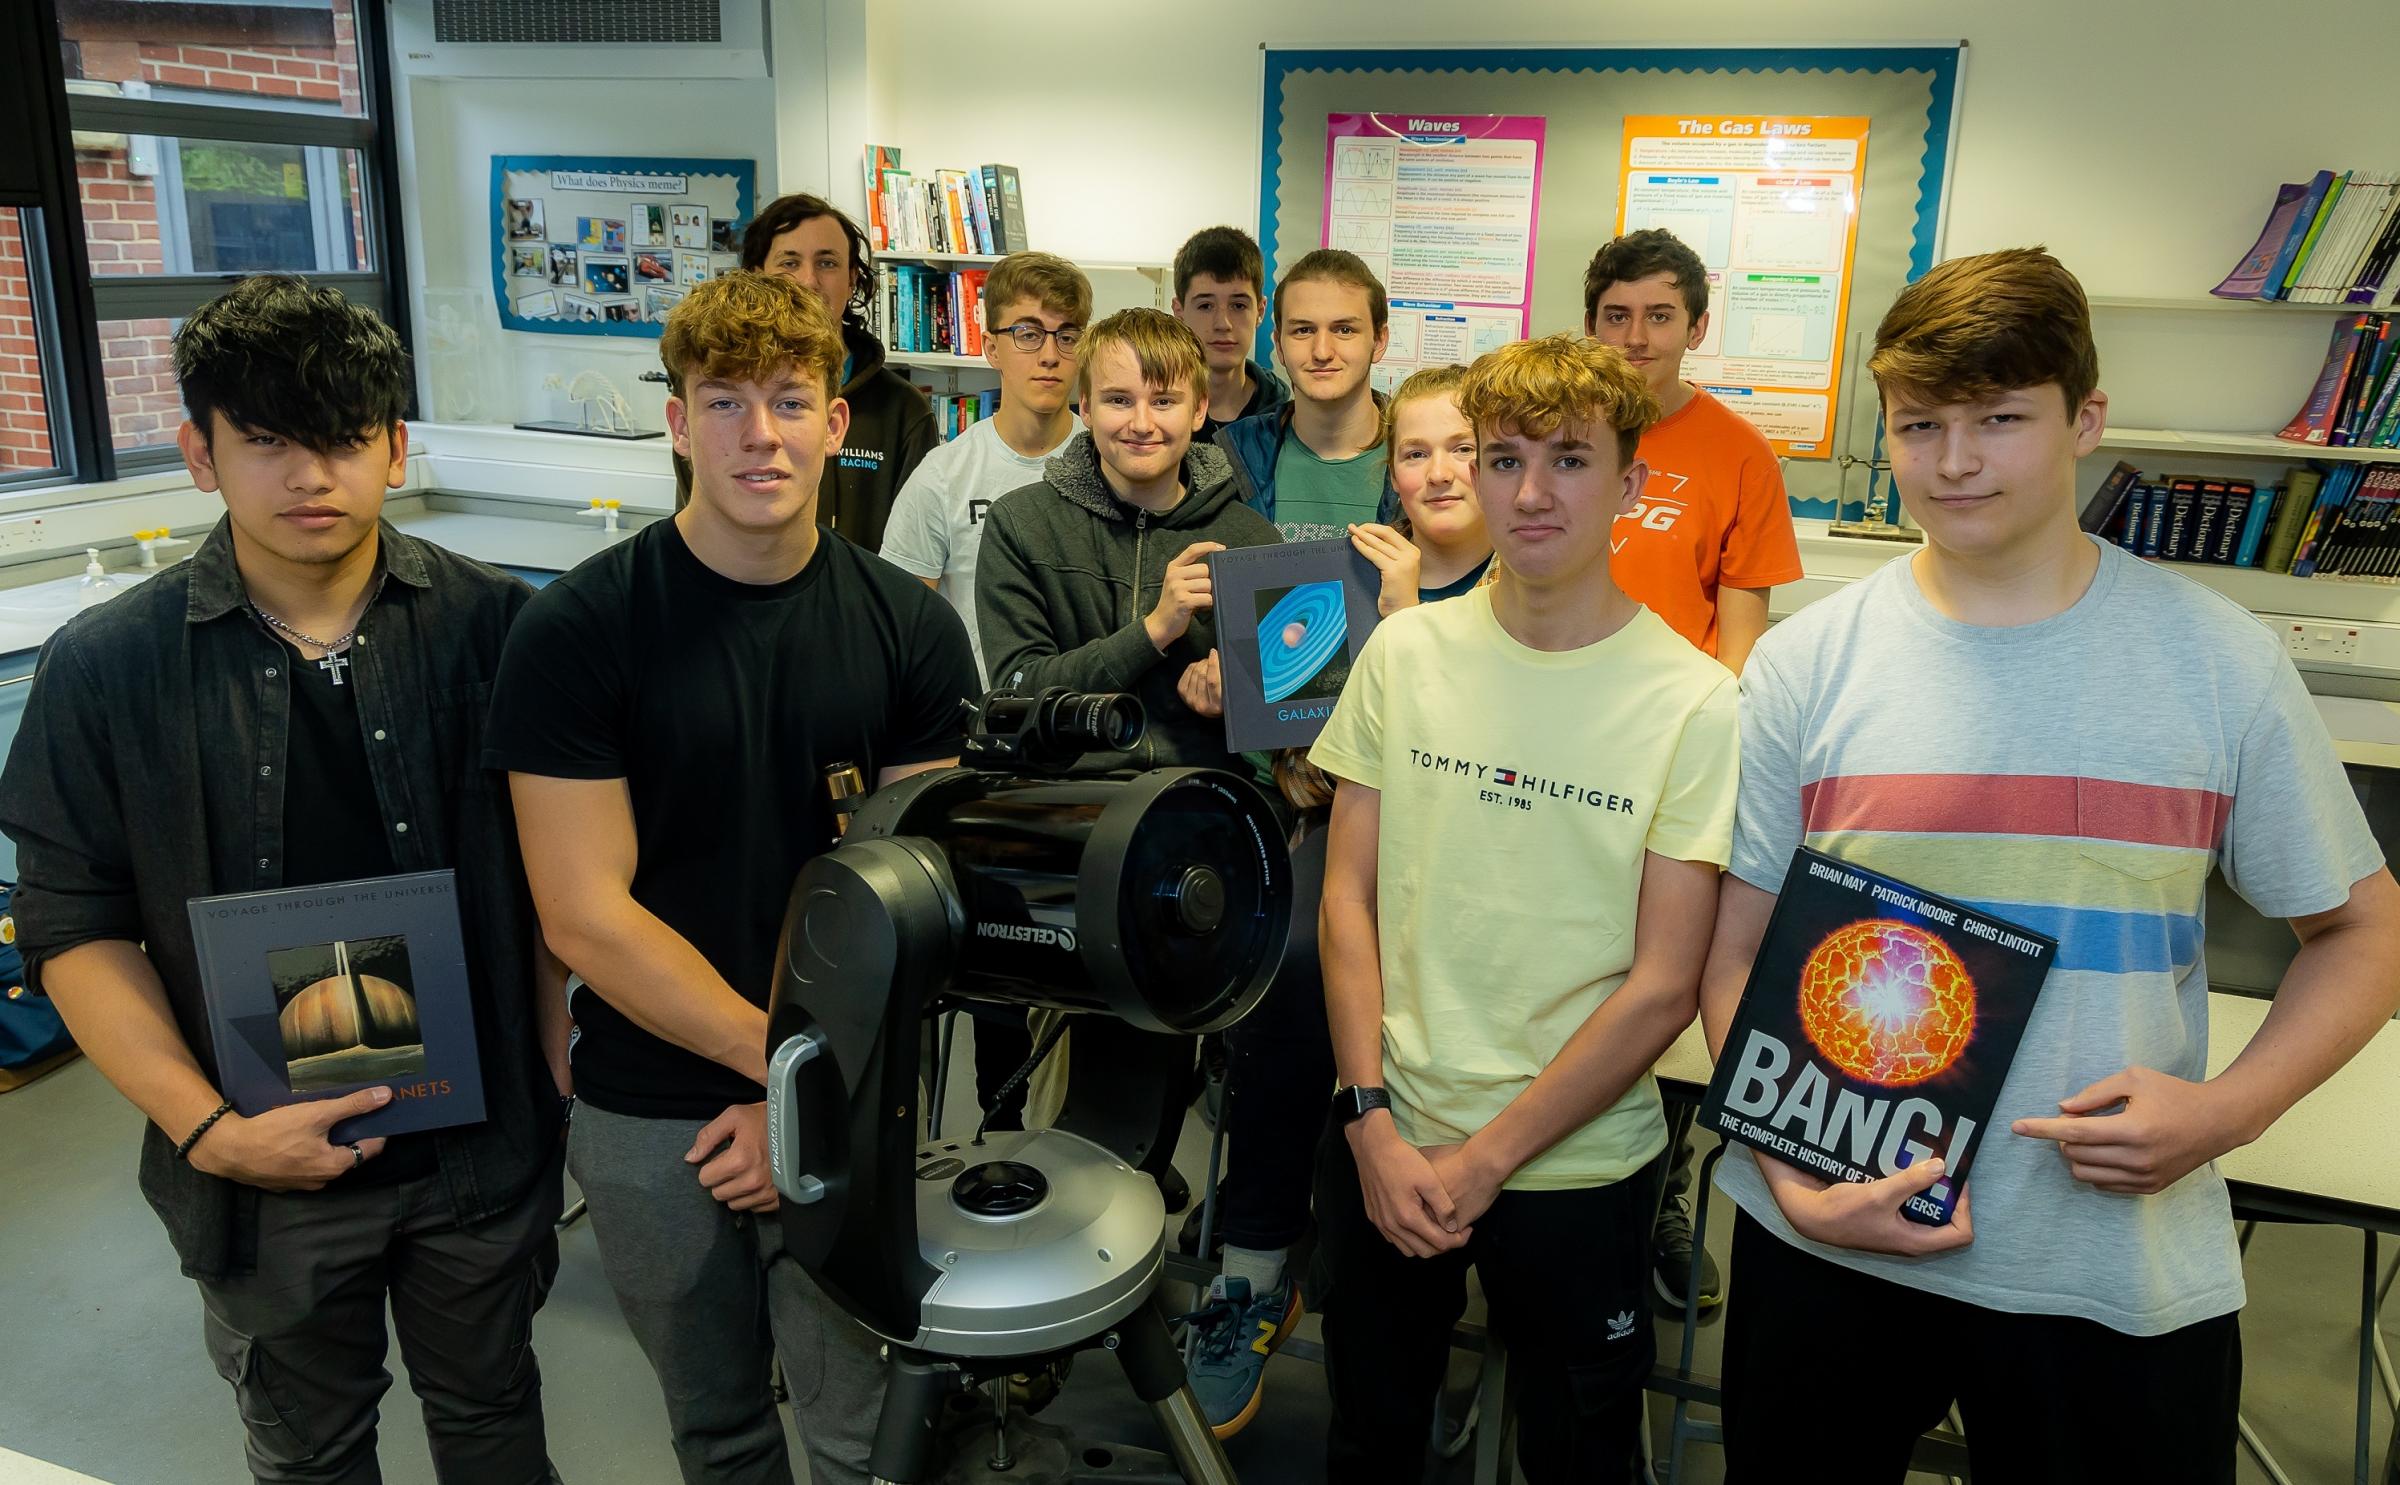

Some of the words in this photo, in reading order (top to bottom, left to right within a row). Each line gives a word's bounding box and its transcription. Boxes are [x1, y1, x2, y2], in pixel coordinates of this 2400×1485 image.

[1408, 119, 1460, 132] Waves
[1678, 120, 1713, 134] The
[1719, 121, 1753, 135] Gas
[1760, 121, 1811, 135] Laws
[557, 174, 582, 186] What
[586, 176, 607, 187] does
[609, 176, 645, 191] Physics
[648, 180, 682, 190] meme?
[840, 457, 878, 470] RACING
[2125, 502, 2142, 544] Dictionary
[2146, 504, 2163, 546] Dictionary
[2162, 505, 2189, 558] Dictionary
[2188, 506, 2217, 559] Dictionary
[2213, 508, 2243, 560] Dictionary
[1263, 549, 1305, 560] THROUGH
[1278, 706, 1334, 721] GALAXI
[1411, 750, 1488, 778] TOMMY
[1522, 775, 1634, 814] HILFIGER
[1480, 790, 1503, 805] EST.
[1508, 796, 1532, 810] 1985
[207, 903, 268, 919] VOYAGE
[276, 896, 345, 912] THROUGH
[354, 892, 377, 903] THE
[384, 883, 451, 900] UNIVERSE
[1809, 862, 1841, 885] BRIAN
[1843, 872, 1867, 893] MAY
[1871, 884, 1917, 912] PATRICK
[1917, 899, 1957, 927] MOORE
[1963, 918, 1997, 942] CHRIS
[1998, 929, 2044, 958] LINTOTT
[977, 922, 1056, 945] CELESTRON
[1724, 1028, 1976, 1201] BANG!
[1719, 1112, 1739, 1132] THE
[1740, 1121, 1799, 1156] COMPLETE
[1797, 1146, 1847, 1177] HISTORY
[1845, 1167, 1864, 1183] OF
[1607, 1326, 1635, 1340] adidas
